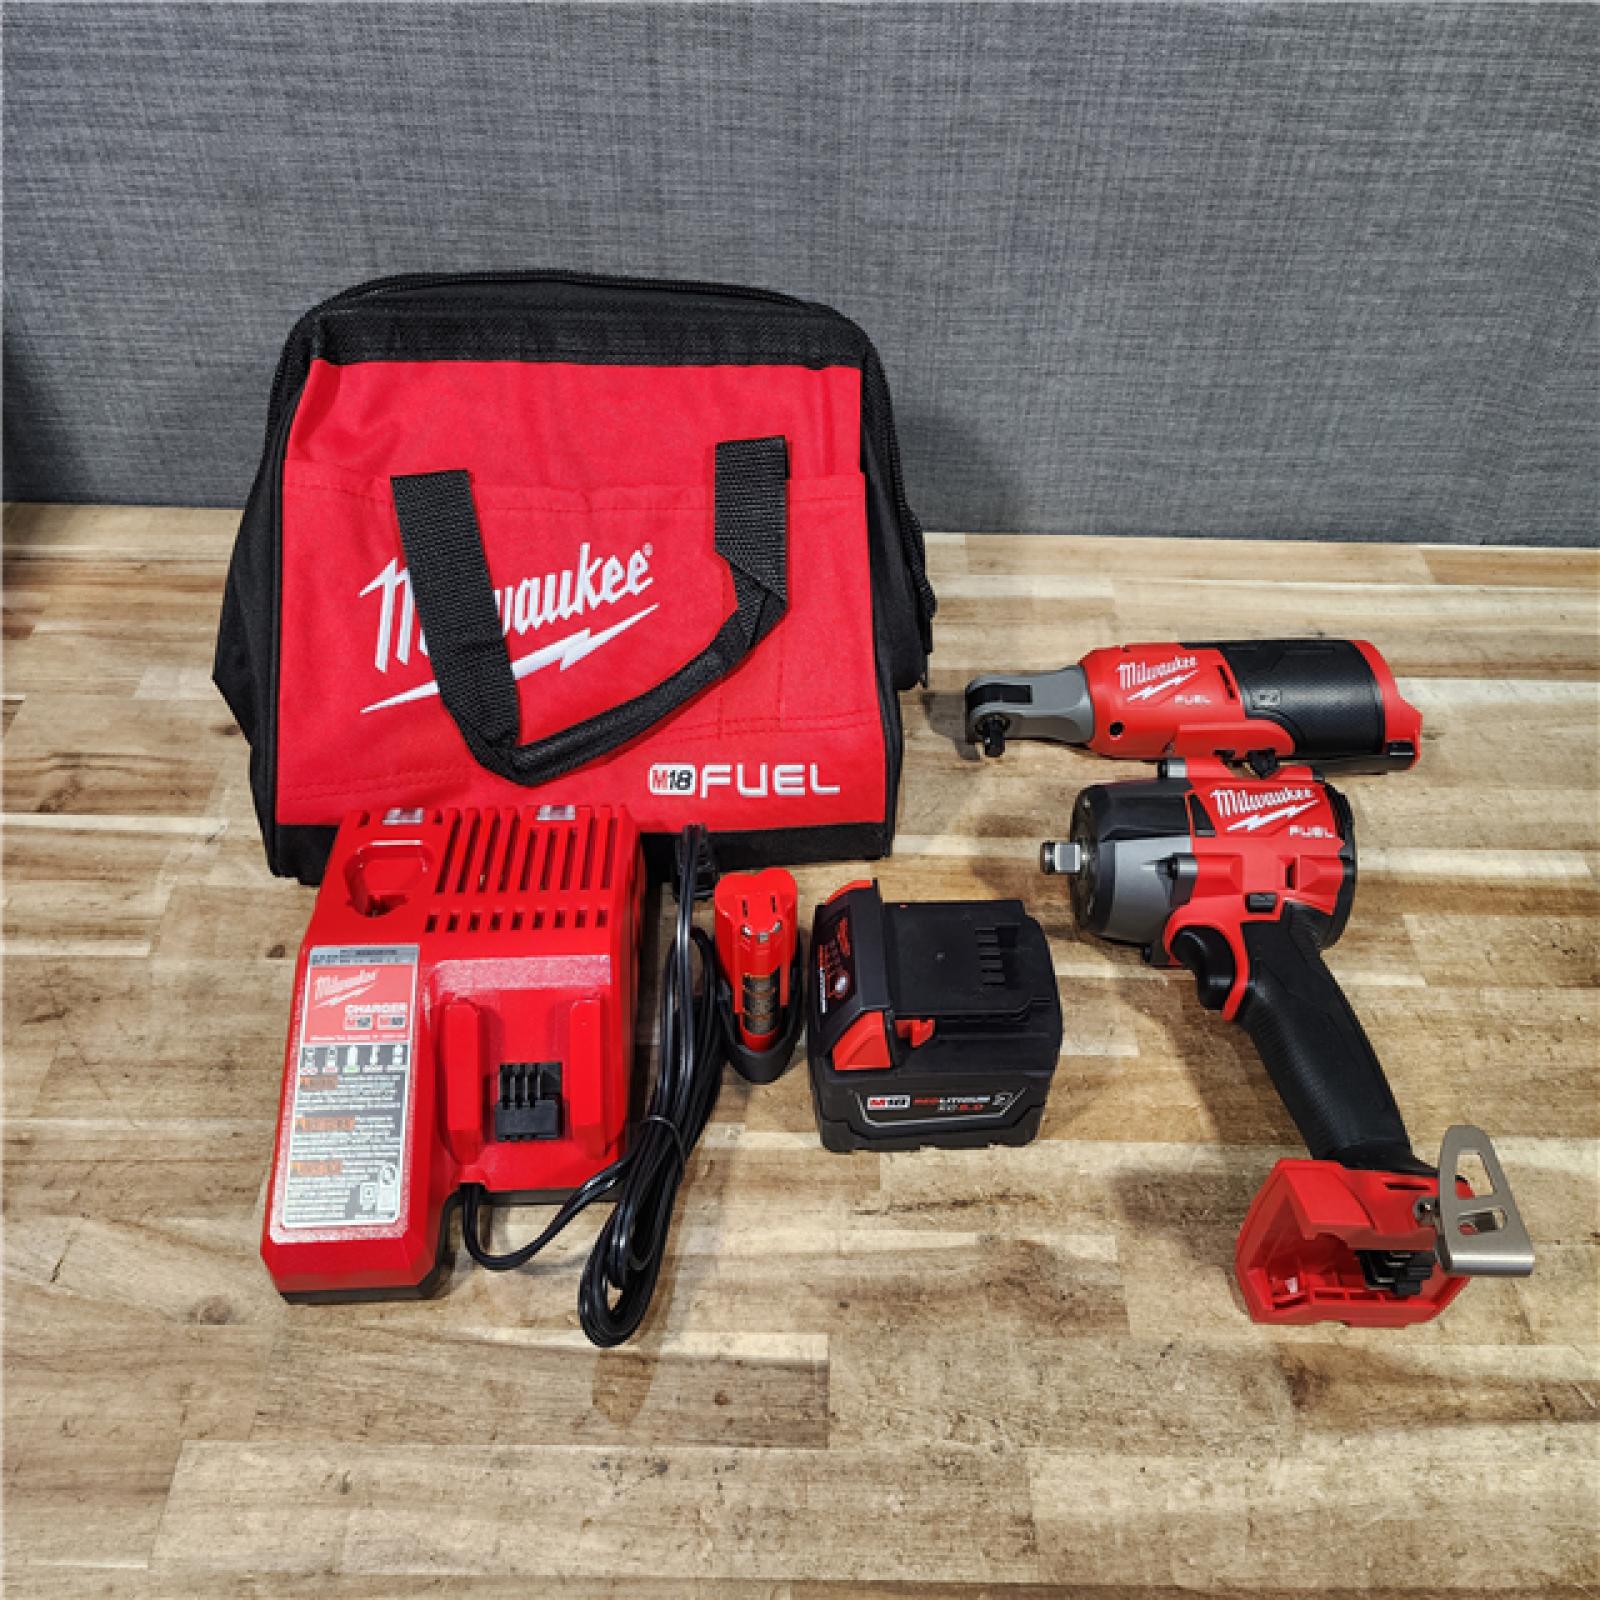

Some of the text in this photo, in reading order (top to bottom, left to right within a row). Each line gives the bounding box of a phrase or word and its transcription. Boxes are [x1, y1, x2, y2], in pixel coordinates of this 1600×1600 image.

[1115, 656, 1198, 691] Milwaukee
[1174, 695, 1212, 705] FUEL
[650, 763, 841, 799] M18 FUEL
[1210, 786, 1315, 818] Milwaukee
[1289, 825, 1336, 839] FUEL
